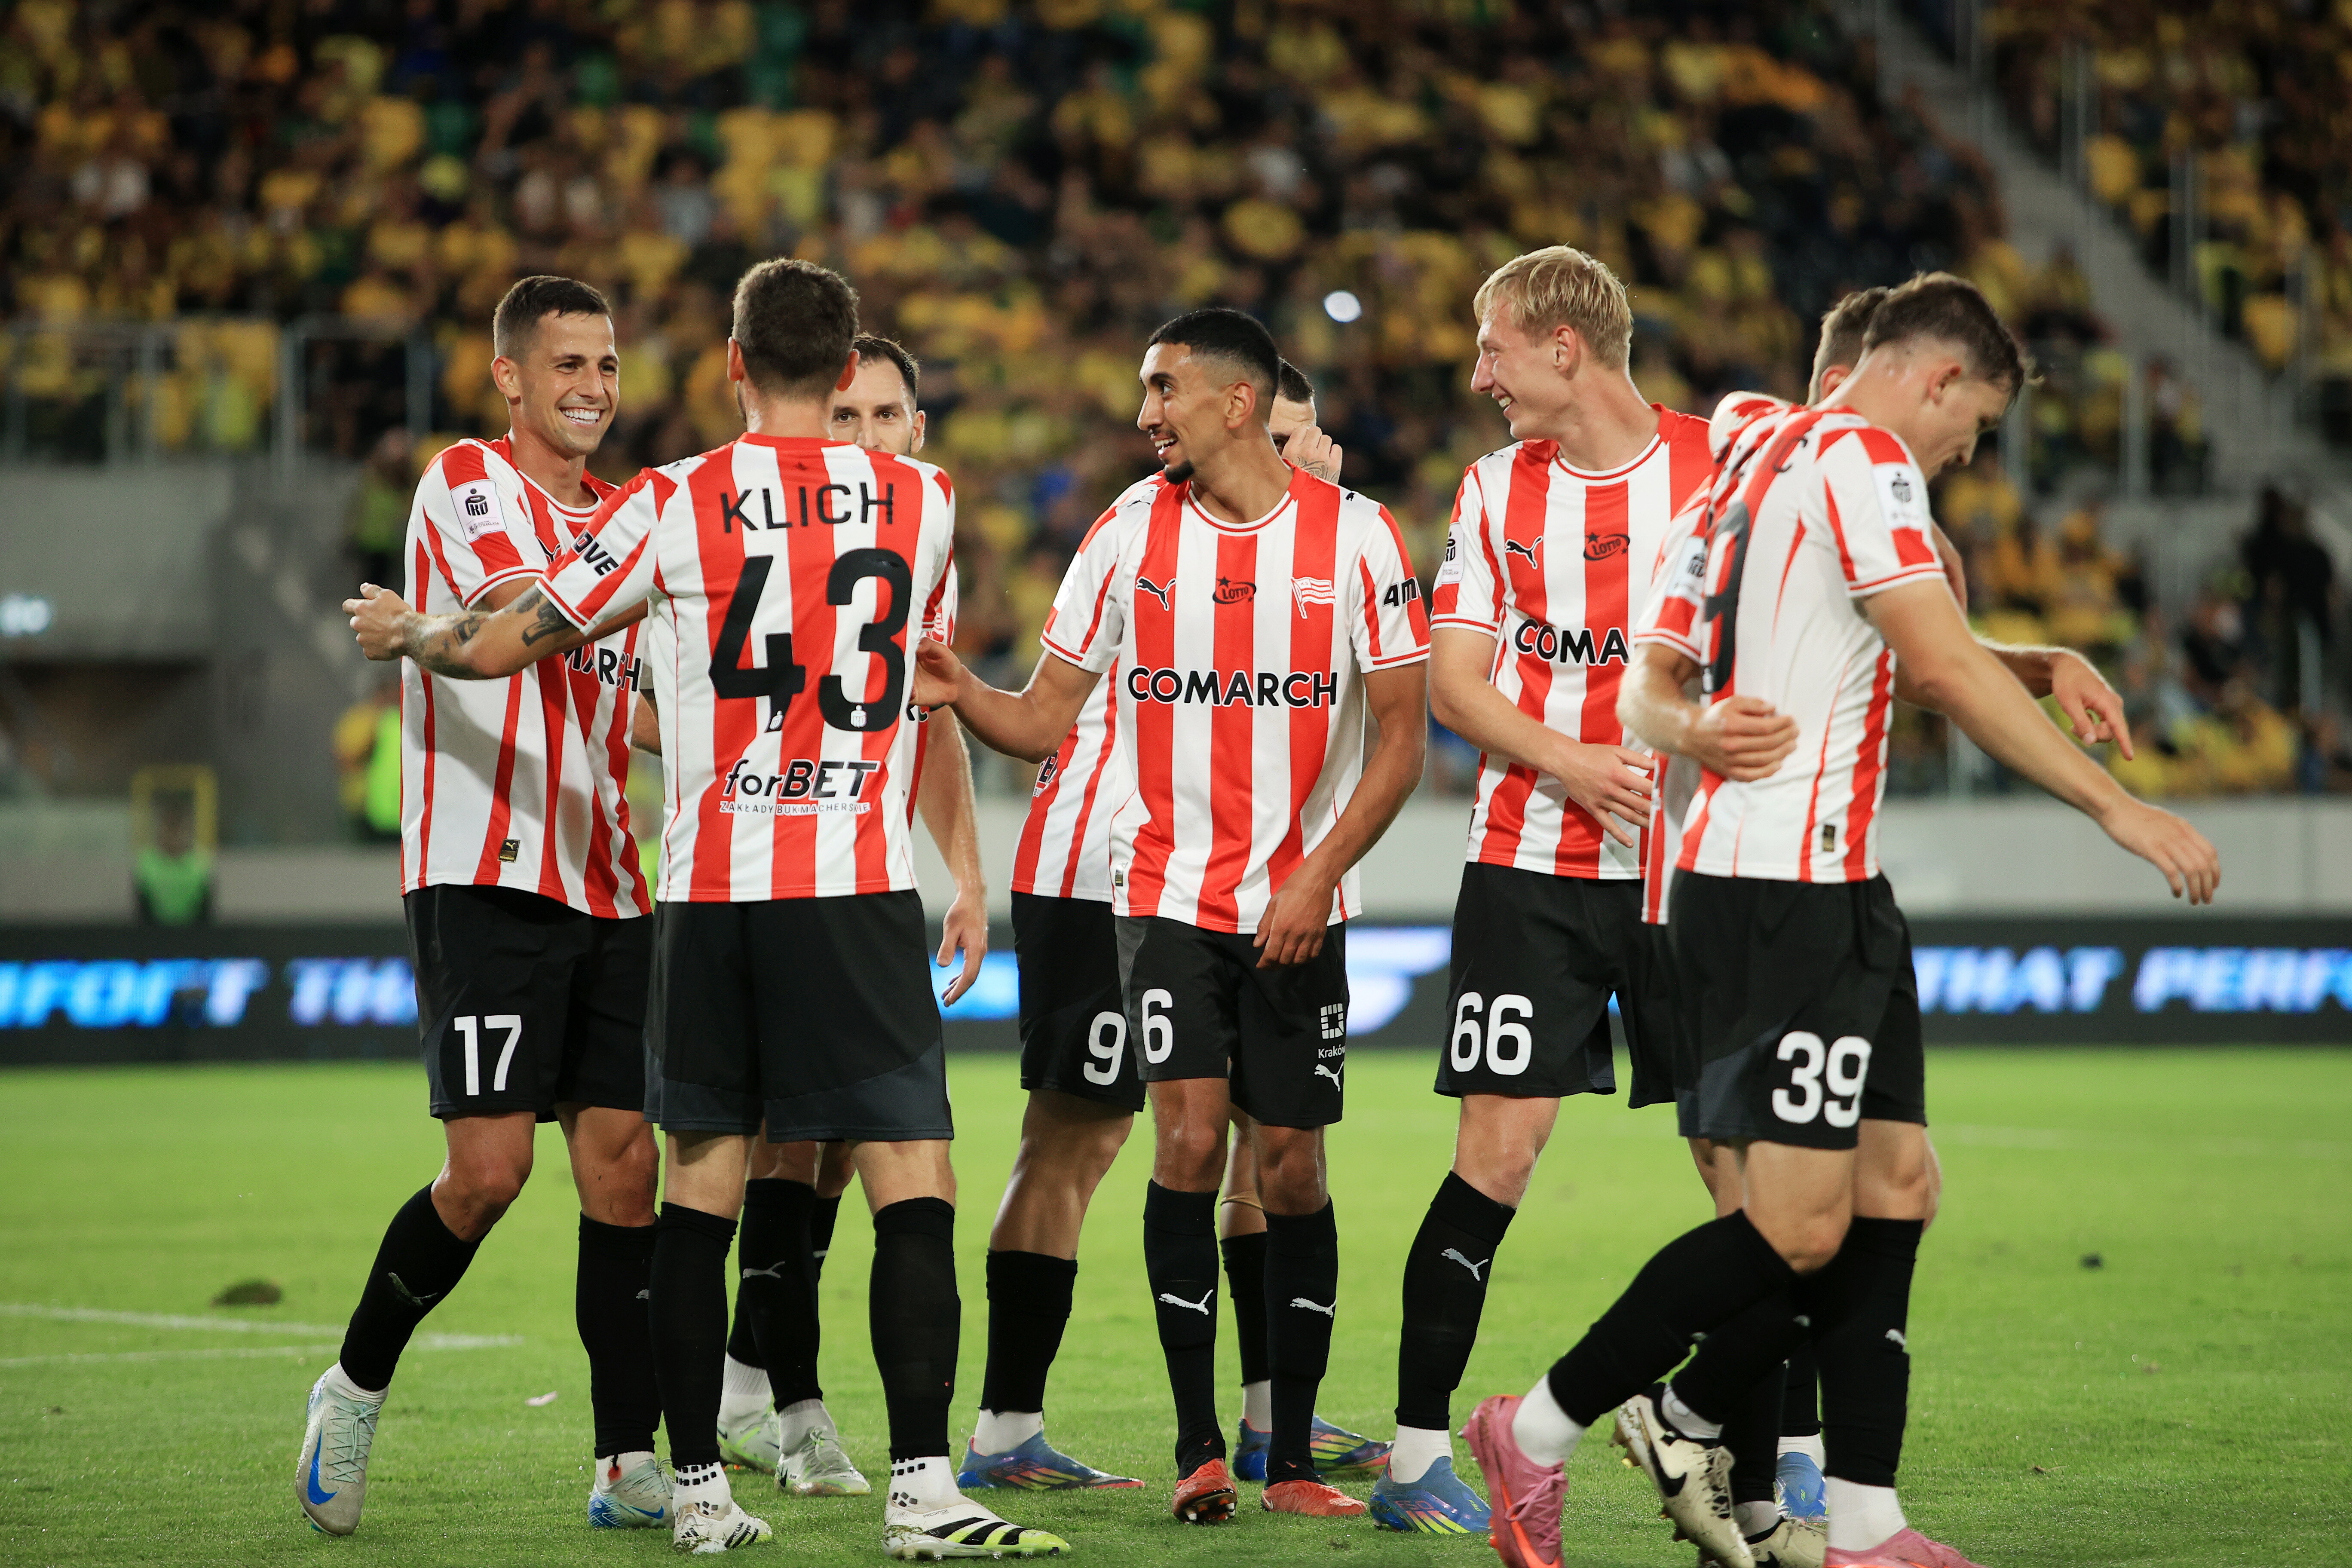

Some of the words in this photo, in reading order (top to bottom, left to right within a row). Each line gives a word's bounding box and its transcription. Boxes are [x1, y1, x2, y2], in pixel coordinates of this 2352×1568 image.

[720, 482, 894, 533] KLICH
[1222, 587, 1249, 600] LOTTO
[708, 548, 912, 733] 43
[1128, 668, 1337, 708] COMARCH
[721, 802, 774, 814] ZAKŁADY
[777, 802, 869, 814] BUKMACHERSKIE
[724, 759, 879, 799] forBET
[454, 1014, 522, 1096] 17
[1083, 1011, 1126, 1085] 9
[1142, 988, 1173, 1064] 6
[1451, 992, 1533, 1076] 66
[1772, 1030, 1872, 1128] 39
[923, 1509, 948, 1518] PREDATOR
